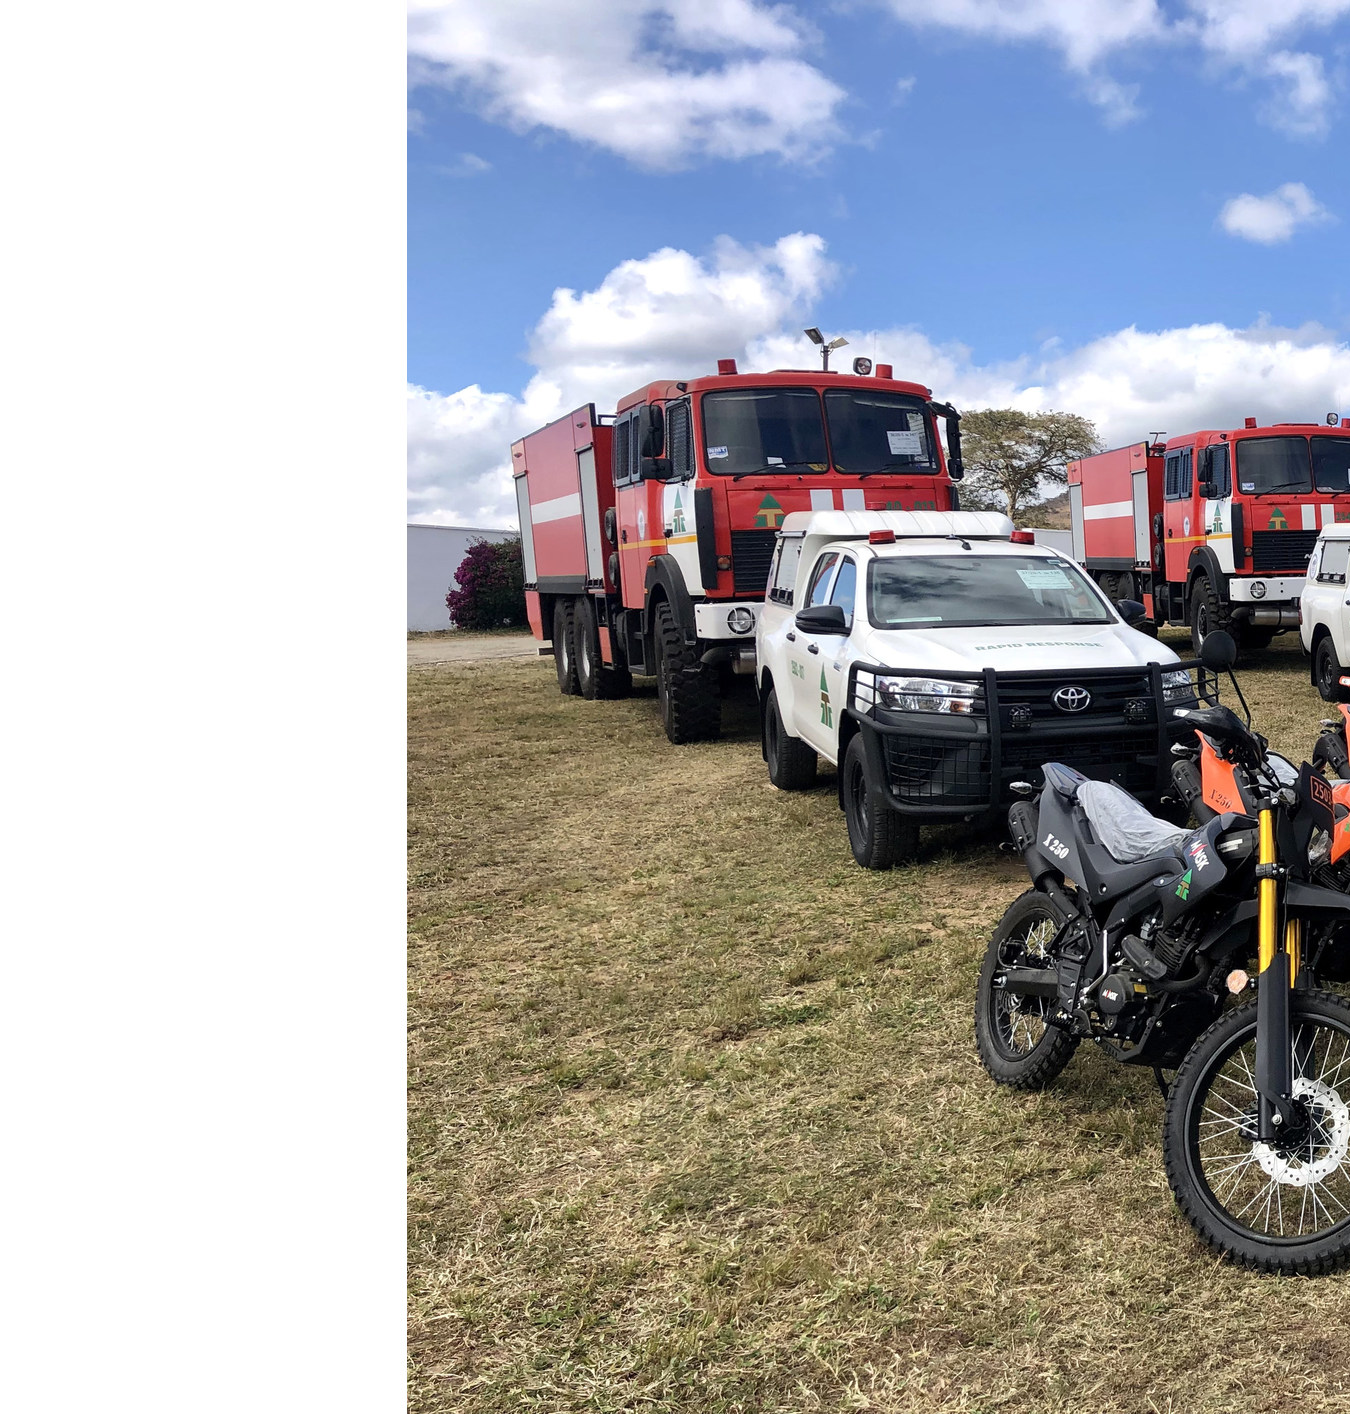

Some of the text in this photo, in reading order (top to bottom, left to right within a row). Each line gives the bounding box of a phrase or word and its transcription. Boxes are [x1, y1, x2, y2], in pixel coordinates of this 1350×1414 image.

[885, 501, 902, 510] 40
[975, 643, 1023, 651] RAPID
[1208, 789, 1233, 809] X 250
[1042, 833, 1070, 859] X 250
[1189, 839, 1210, 872] MINSK
